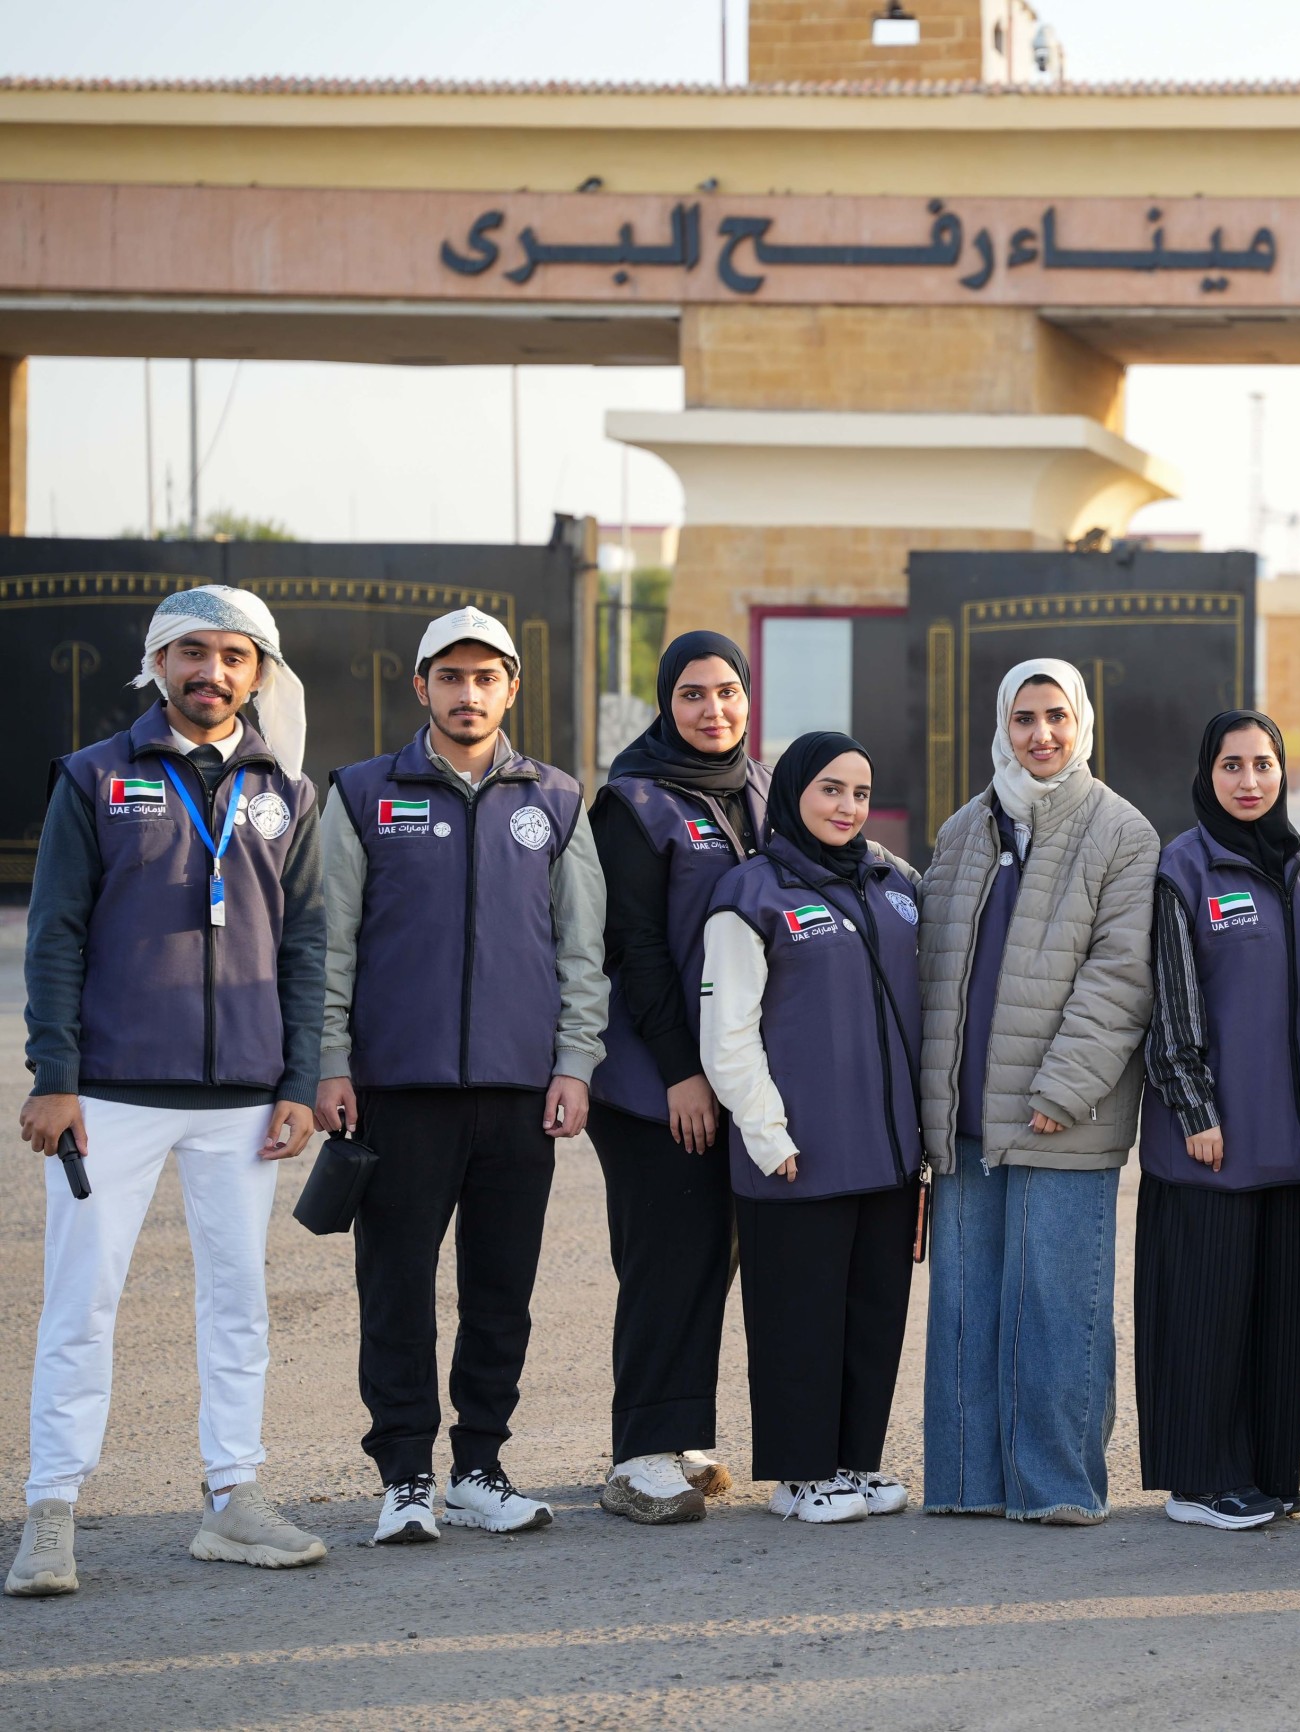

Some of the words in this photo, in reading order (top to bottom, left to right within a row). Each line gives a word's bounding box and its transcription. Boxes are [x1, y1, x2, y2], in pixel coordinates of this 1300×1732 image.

[717, 199, 994, 295] رفح
[1007, 206, 1276, 292] ميناء
[109, 806, 129, 815] UAE
[132, 804, 165, 816] الإمارات
[378, 826, 396, 835] UAE
[398, 824, 429, 834] الإمارات
[693, 842, 709, 850] UAE
[1211, 920, 1229, 931] UAE
[1231, 914, 1258, 926] الإمارات
[811, 923, 838, 936] الإمارات
[791, 931, 810, 942] UAE
